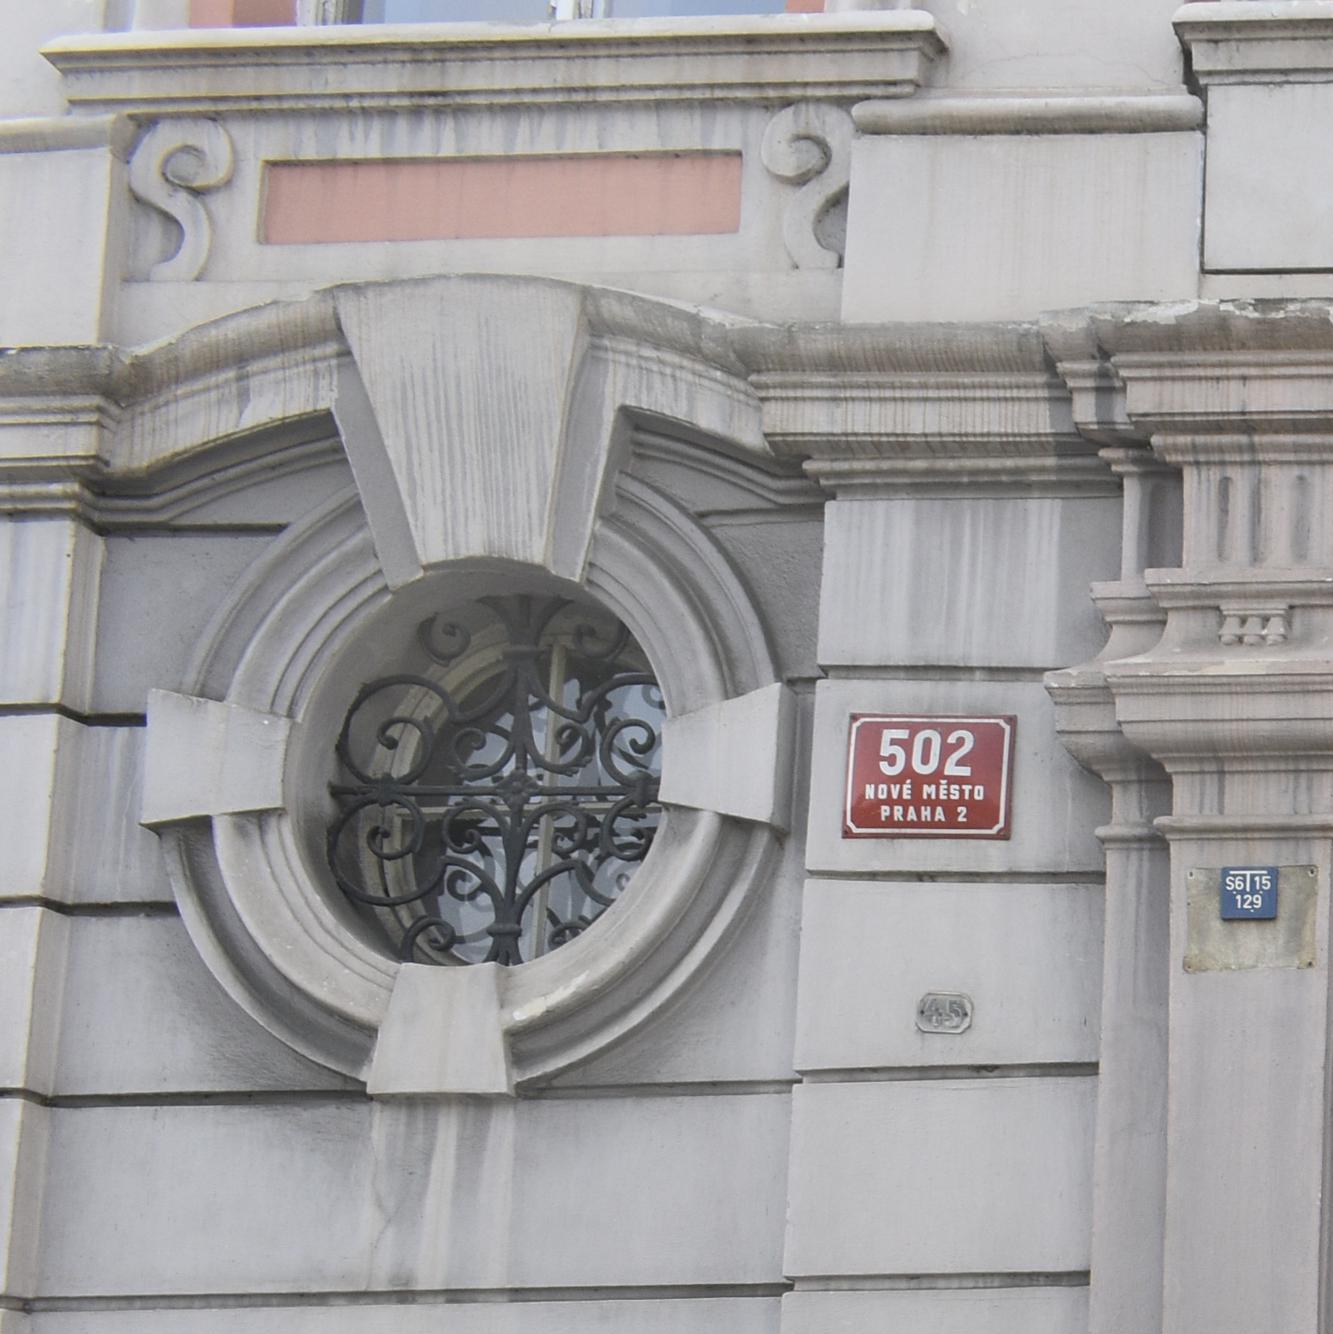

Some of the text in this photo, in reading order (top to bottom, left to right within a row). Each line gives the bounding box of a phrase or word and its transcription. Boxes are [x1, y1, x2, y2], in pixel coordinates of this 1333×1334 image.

[878, 728, 976, 777] 502
[865, 779, 985, 801] NOVÉ MĚSTO
[880, 805, 968, 822] PRAHA 2
